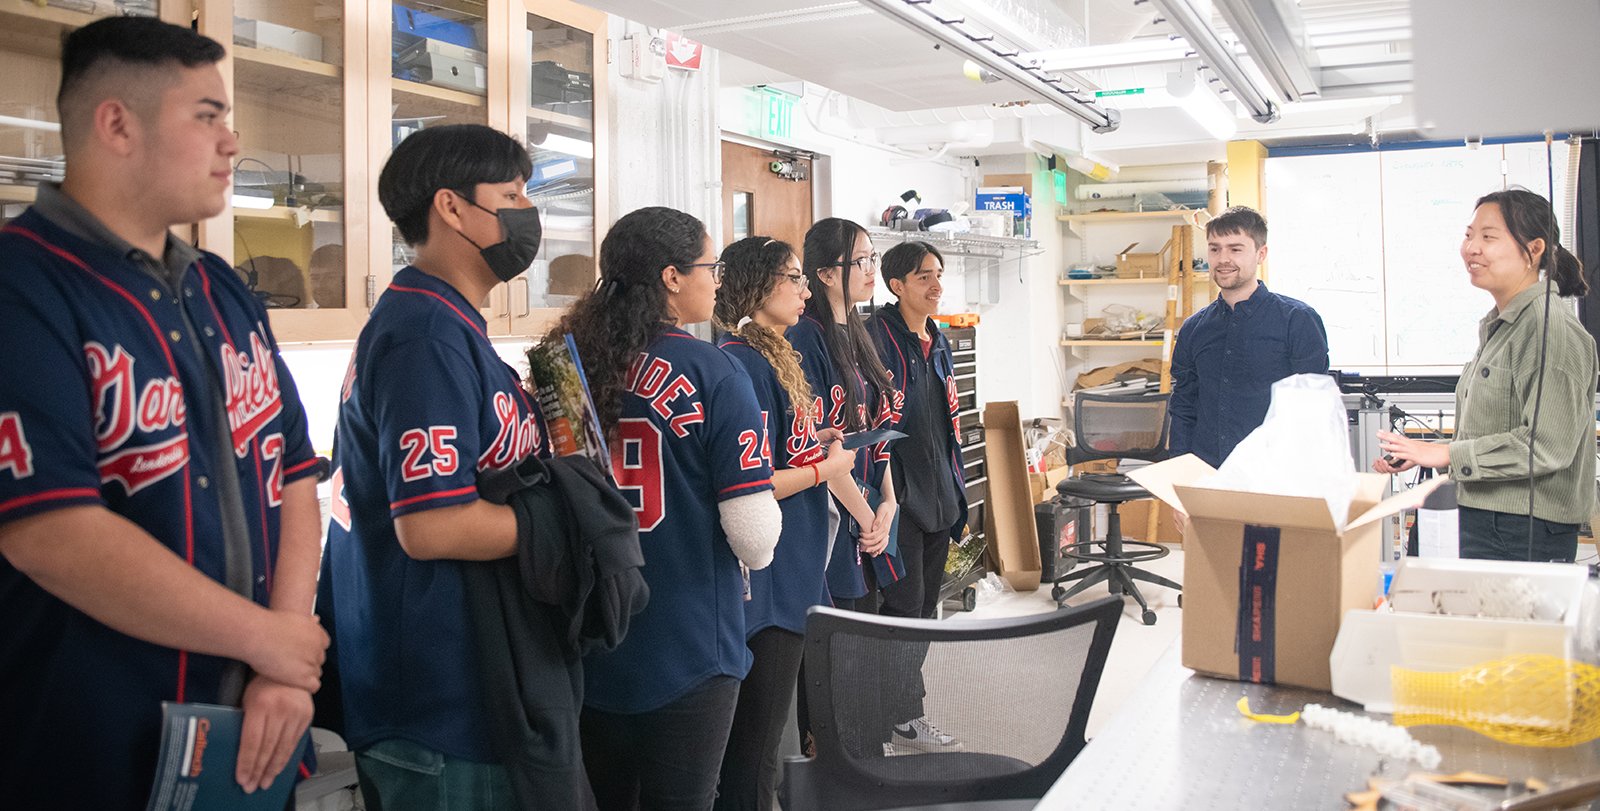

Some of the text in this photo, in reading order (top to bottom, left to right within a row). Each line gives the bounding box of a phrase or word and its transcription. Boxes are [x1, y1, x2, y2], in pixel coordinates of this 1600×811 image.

[768, 96, 795, 138] EXIT
[984, 201, 1015, 210] TRASH
[400, 425, 458, 483] 25
[738, 429, 773, 471] 24
[190, 717, 211, 778] Caltech
